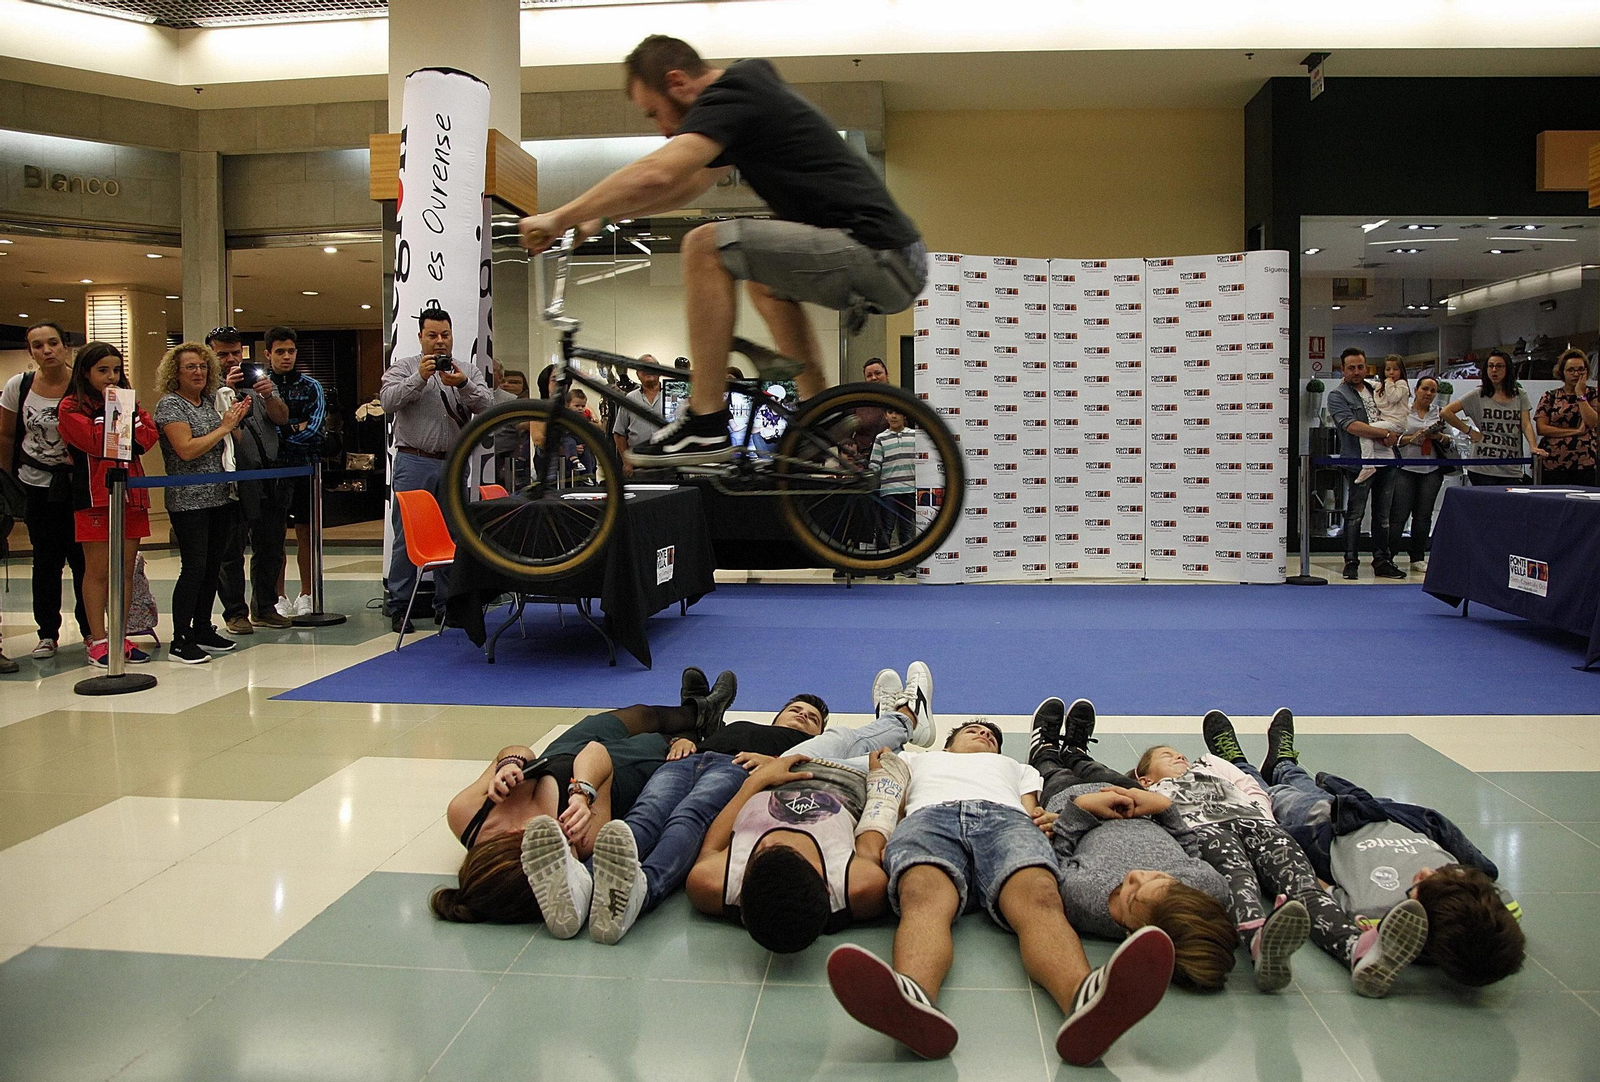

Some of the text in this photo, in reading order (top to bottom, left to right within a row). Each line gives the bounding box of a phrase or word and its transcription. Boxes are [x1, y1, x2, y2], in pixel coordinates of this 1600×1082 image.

[23, 164, 120, 197] Blanco
[428, 250, 445, 282] es
[1482, 408, 1521, 421] ROCK
[1510, 555, 1527, 568] PONTE
[1510, 565, 1527, 577] VELLA
